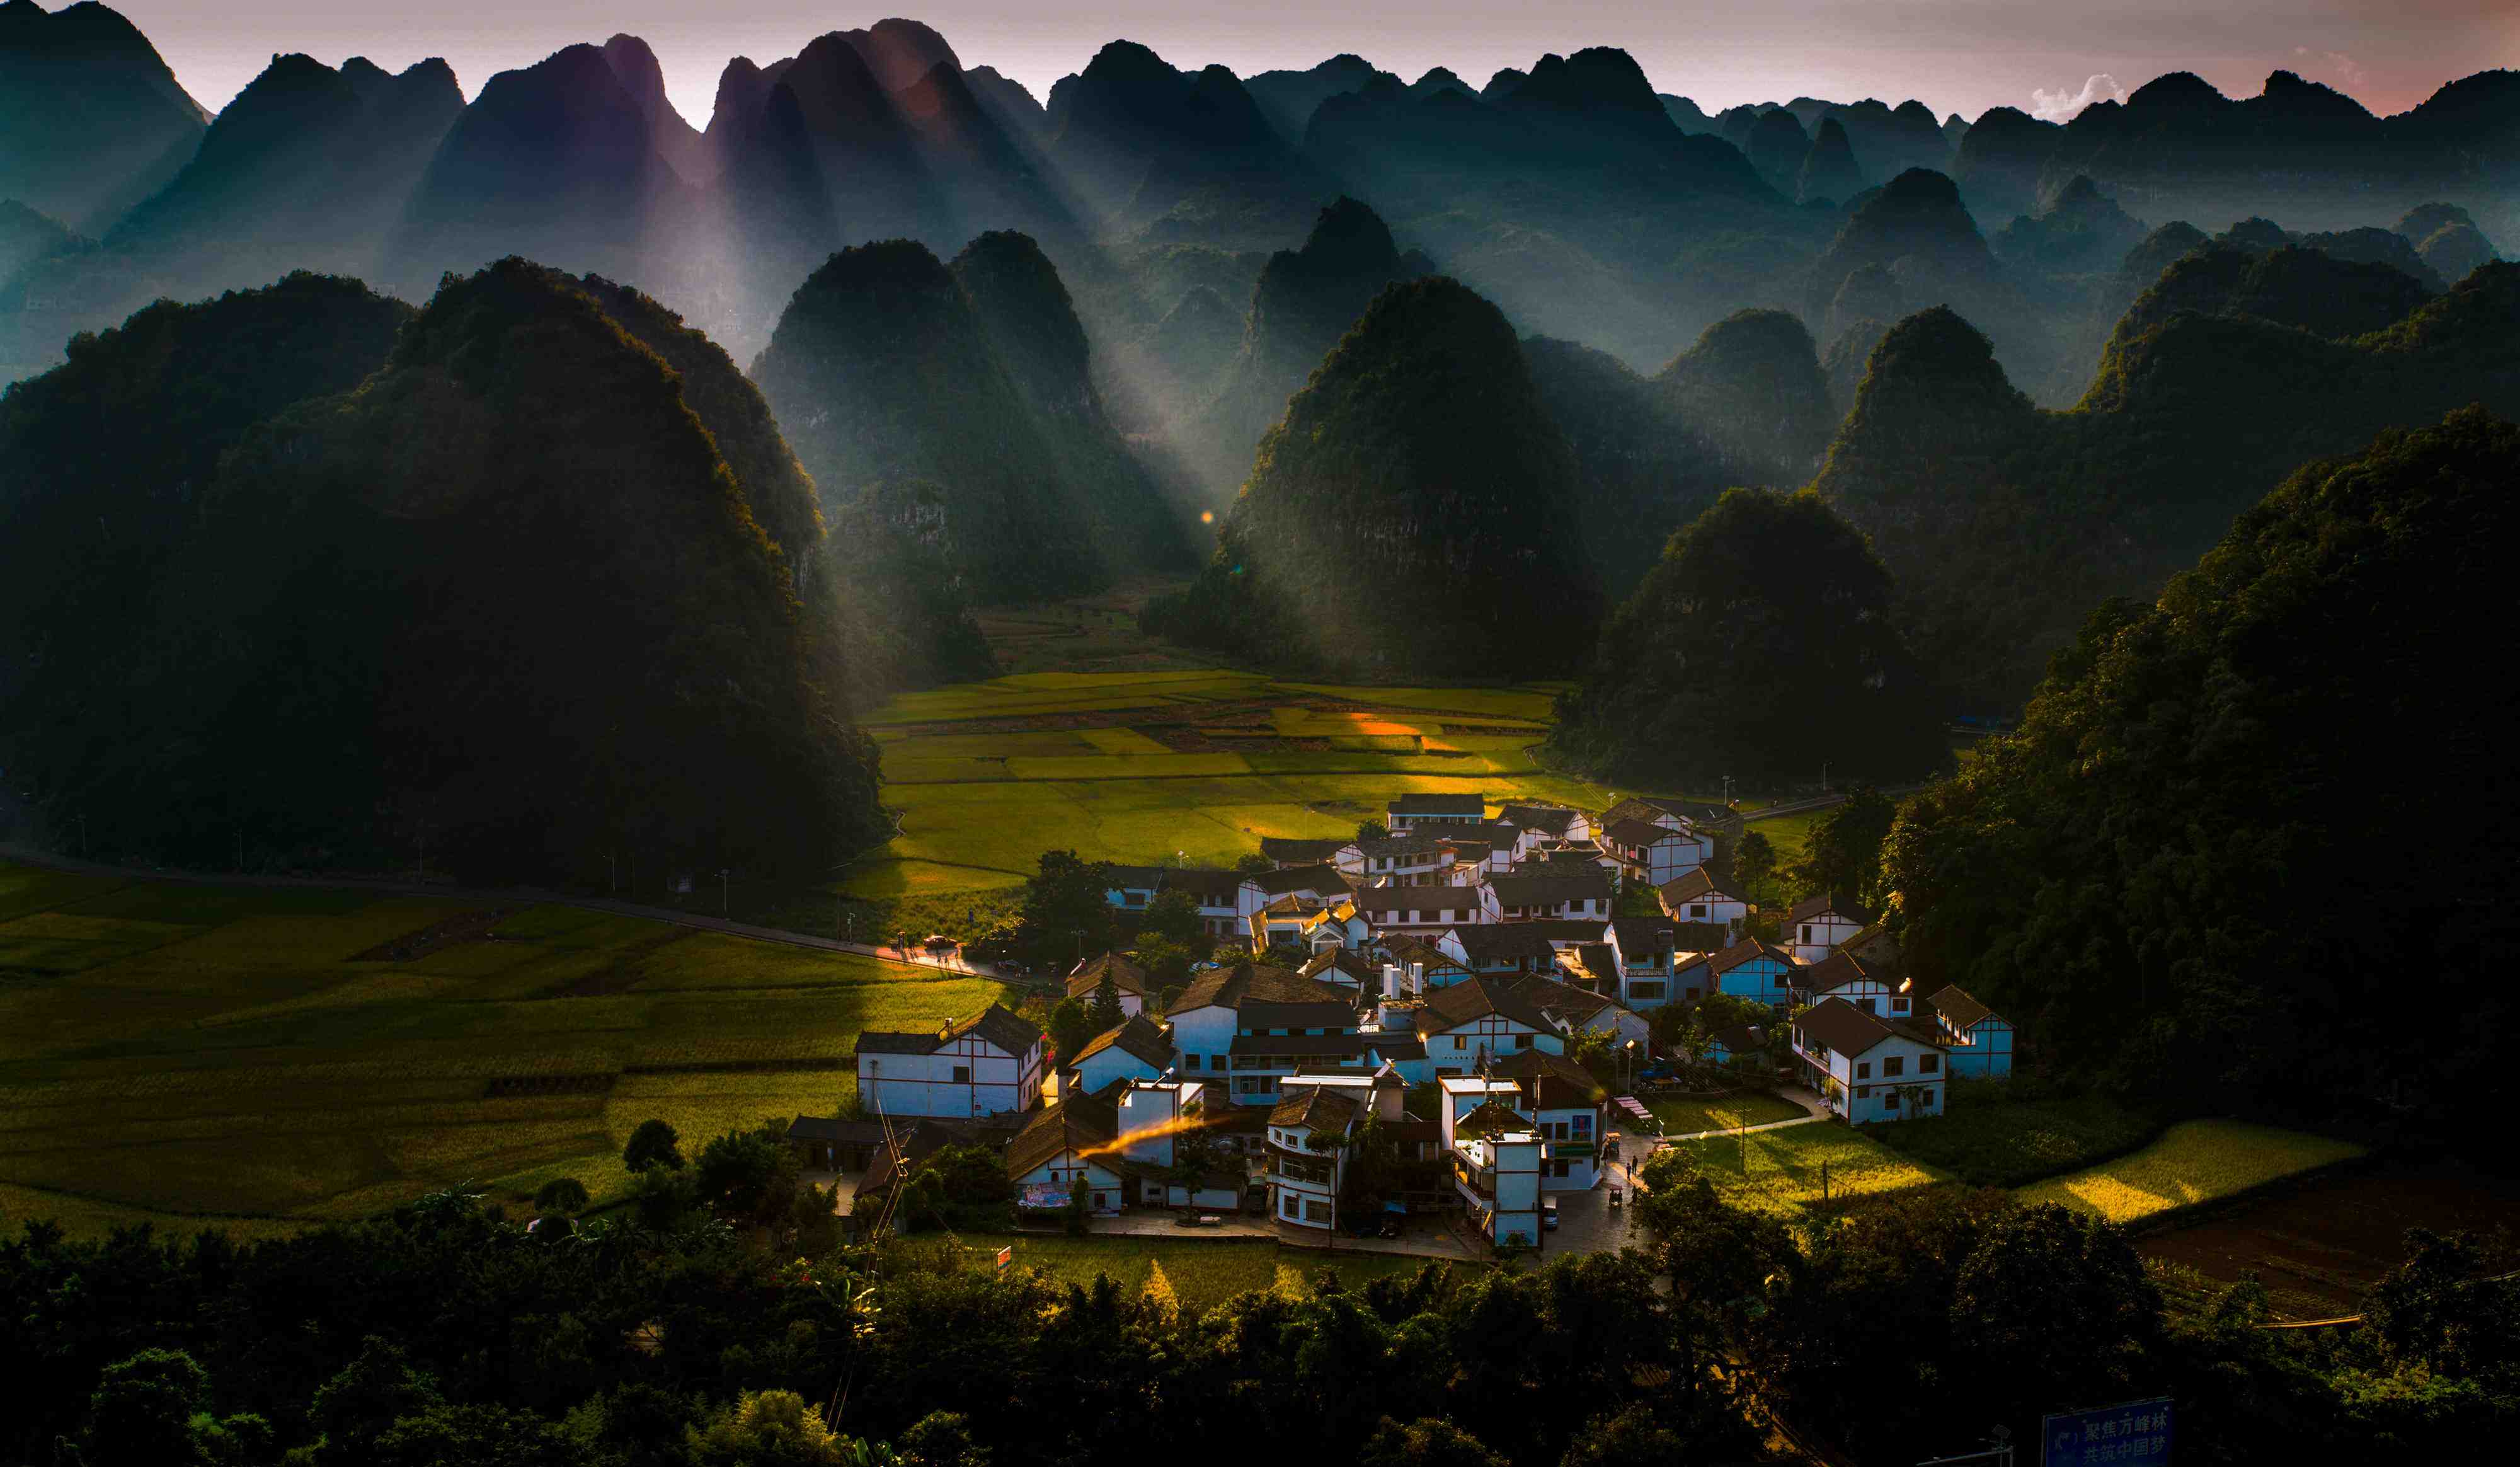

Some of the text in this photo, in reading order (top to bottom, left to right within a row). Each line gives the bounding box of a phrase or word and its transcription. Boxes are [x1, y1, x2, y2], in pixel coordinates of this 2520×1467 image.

[2083, 1434, 2167, 1463] 共筑中国梦
